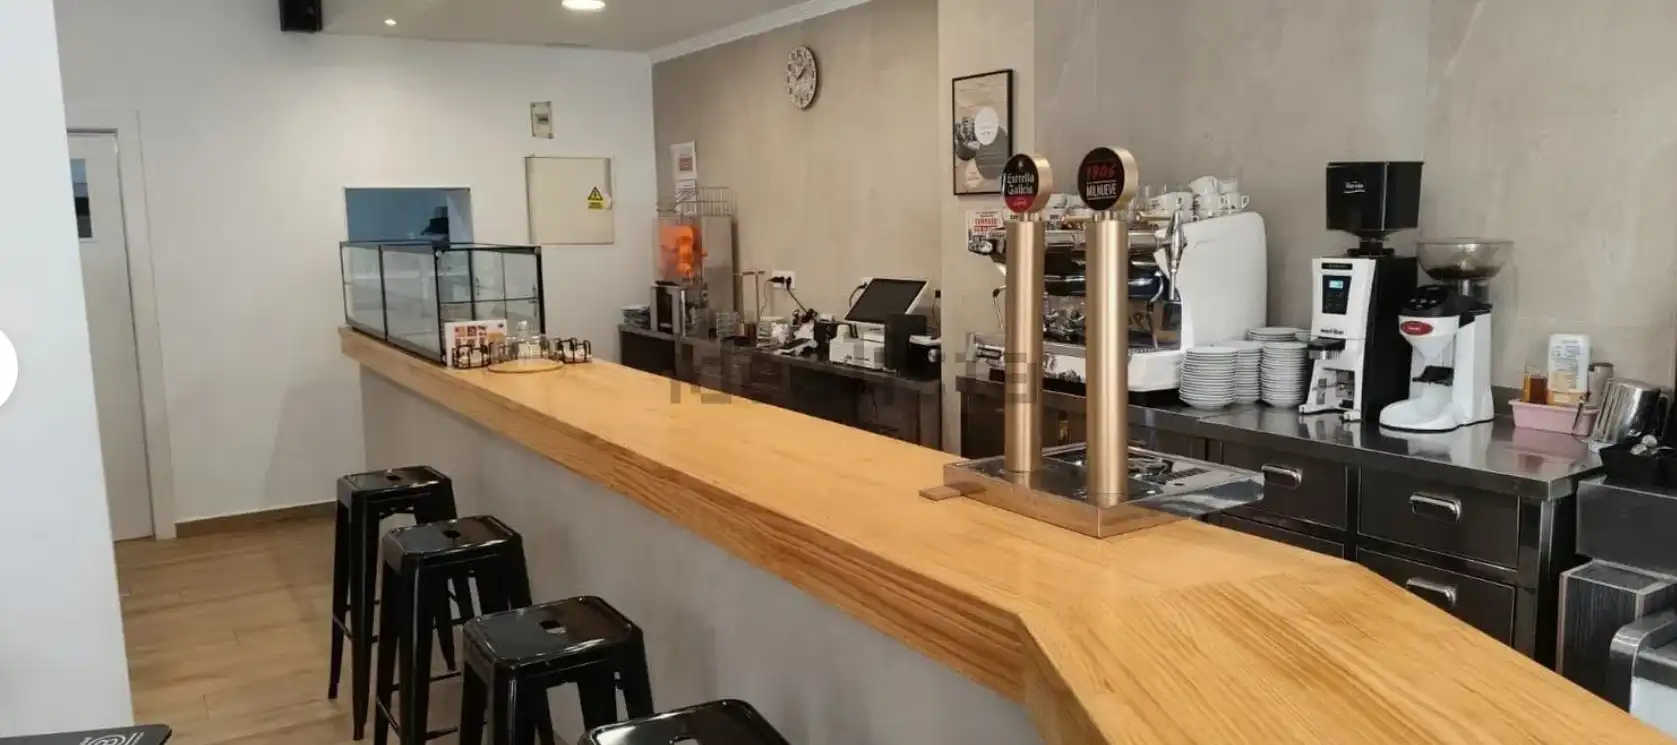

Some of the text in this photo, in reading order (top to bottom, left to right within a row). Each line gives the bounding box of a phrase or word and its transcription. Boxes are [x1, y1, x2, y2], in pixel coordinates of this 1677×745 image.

[1086, 164, 1117, 180] 1906
[1007, 173, 1035, 184] Estrella
[1007, 184, 1034, 196] Galicia
